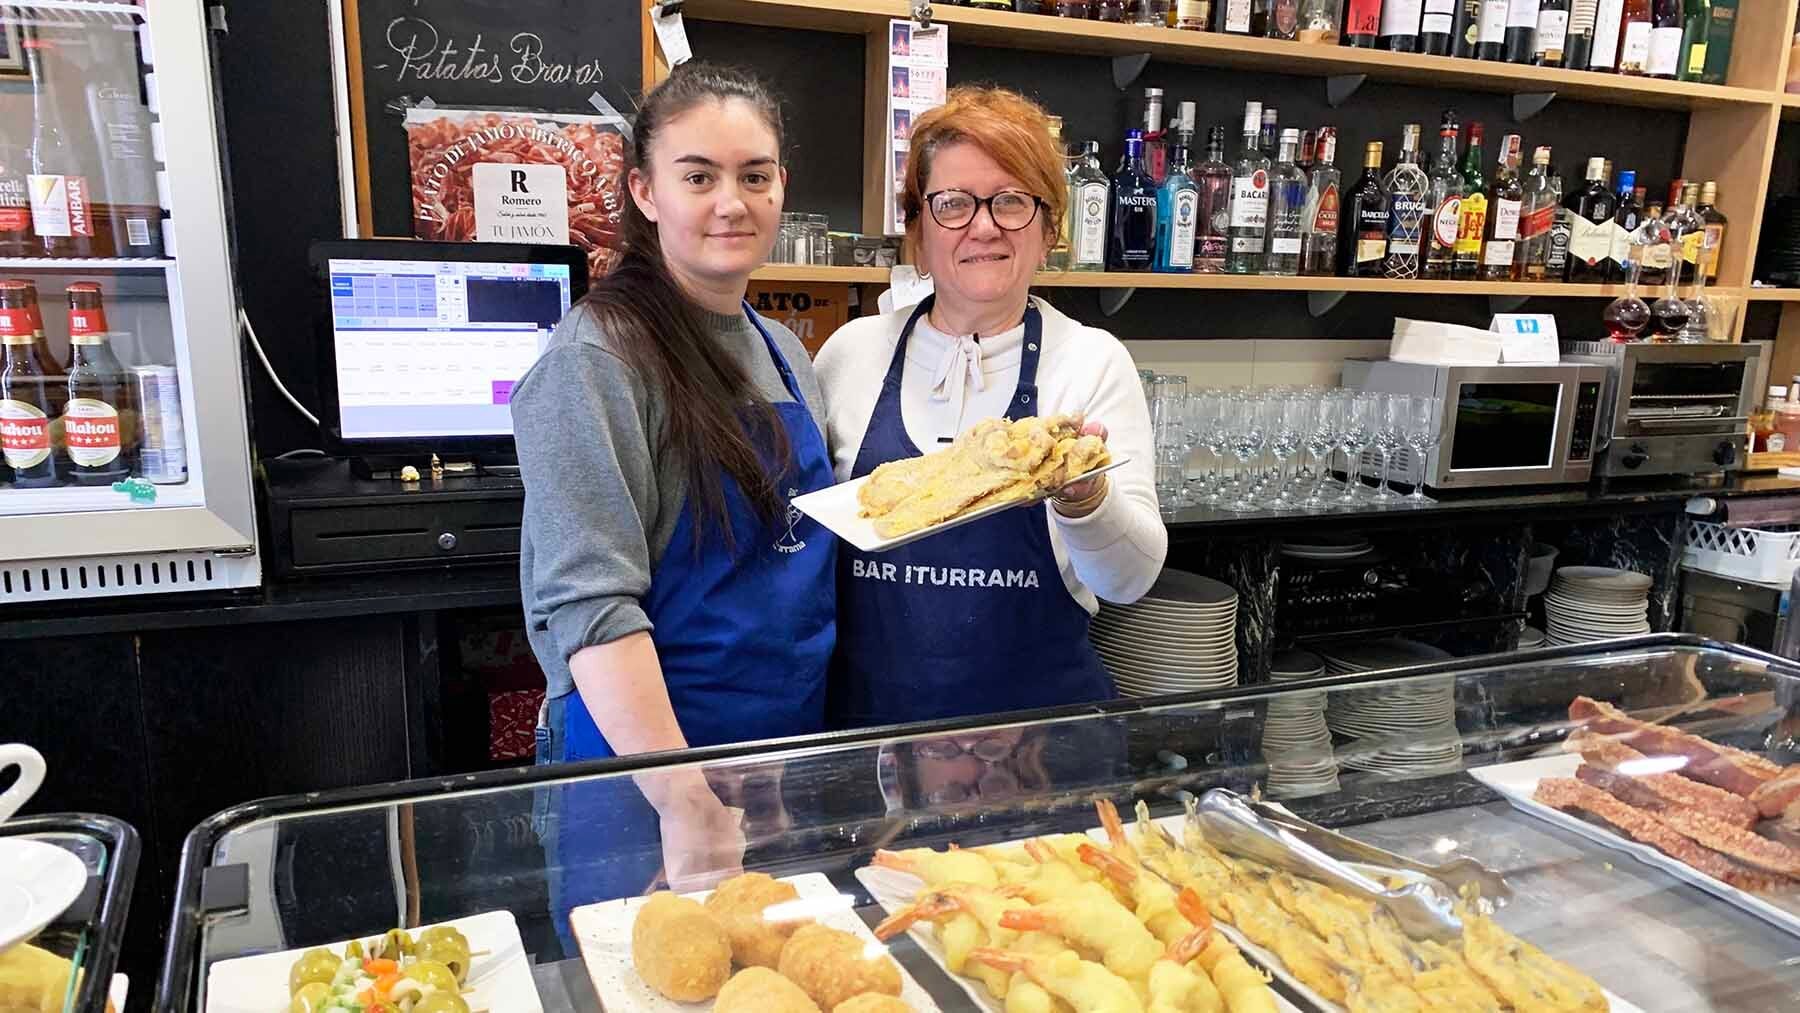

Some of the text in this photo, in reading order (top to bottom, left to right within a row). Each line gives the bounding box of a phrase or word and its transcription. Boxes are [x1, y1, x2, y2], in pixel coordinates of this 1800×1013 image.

[387, 17, 503, 83] Patatas
[445, 141, 466, 165] DE
[464, 121, 530, 154] JAMÓN
[511, 169, 529, 194] R
[67, 178, 88, 235] AMBAR
[501, 194, 542, 206] Romero
[1119, 196, 1157, 207] MASTER'S
[491, 222, 555, 240] TU JAMÓN
[64, 419, 116, 435] Mahou
[852, 558, 1041, 589] BAR ITURRAMA
